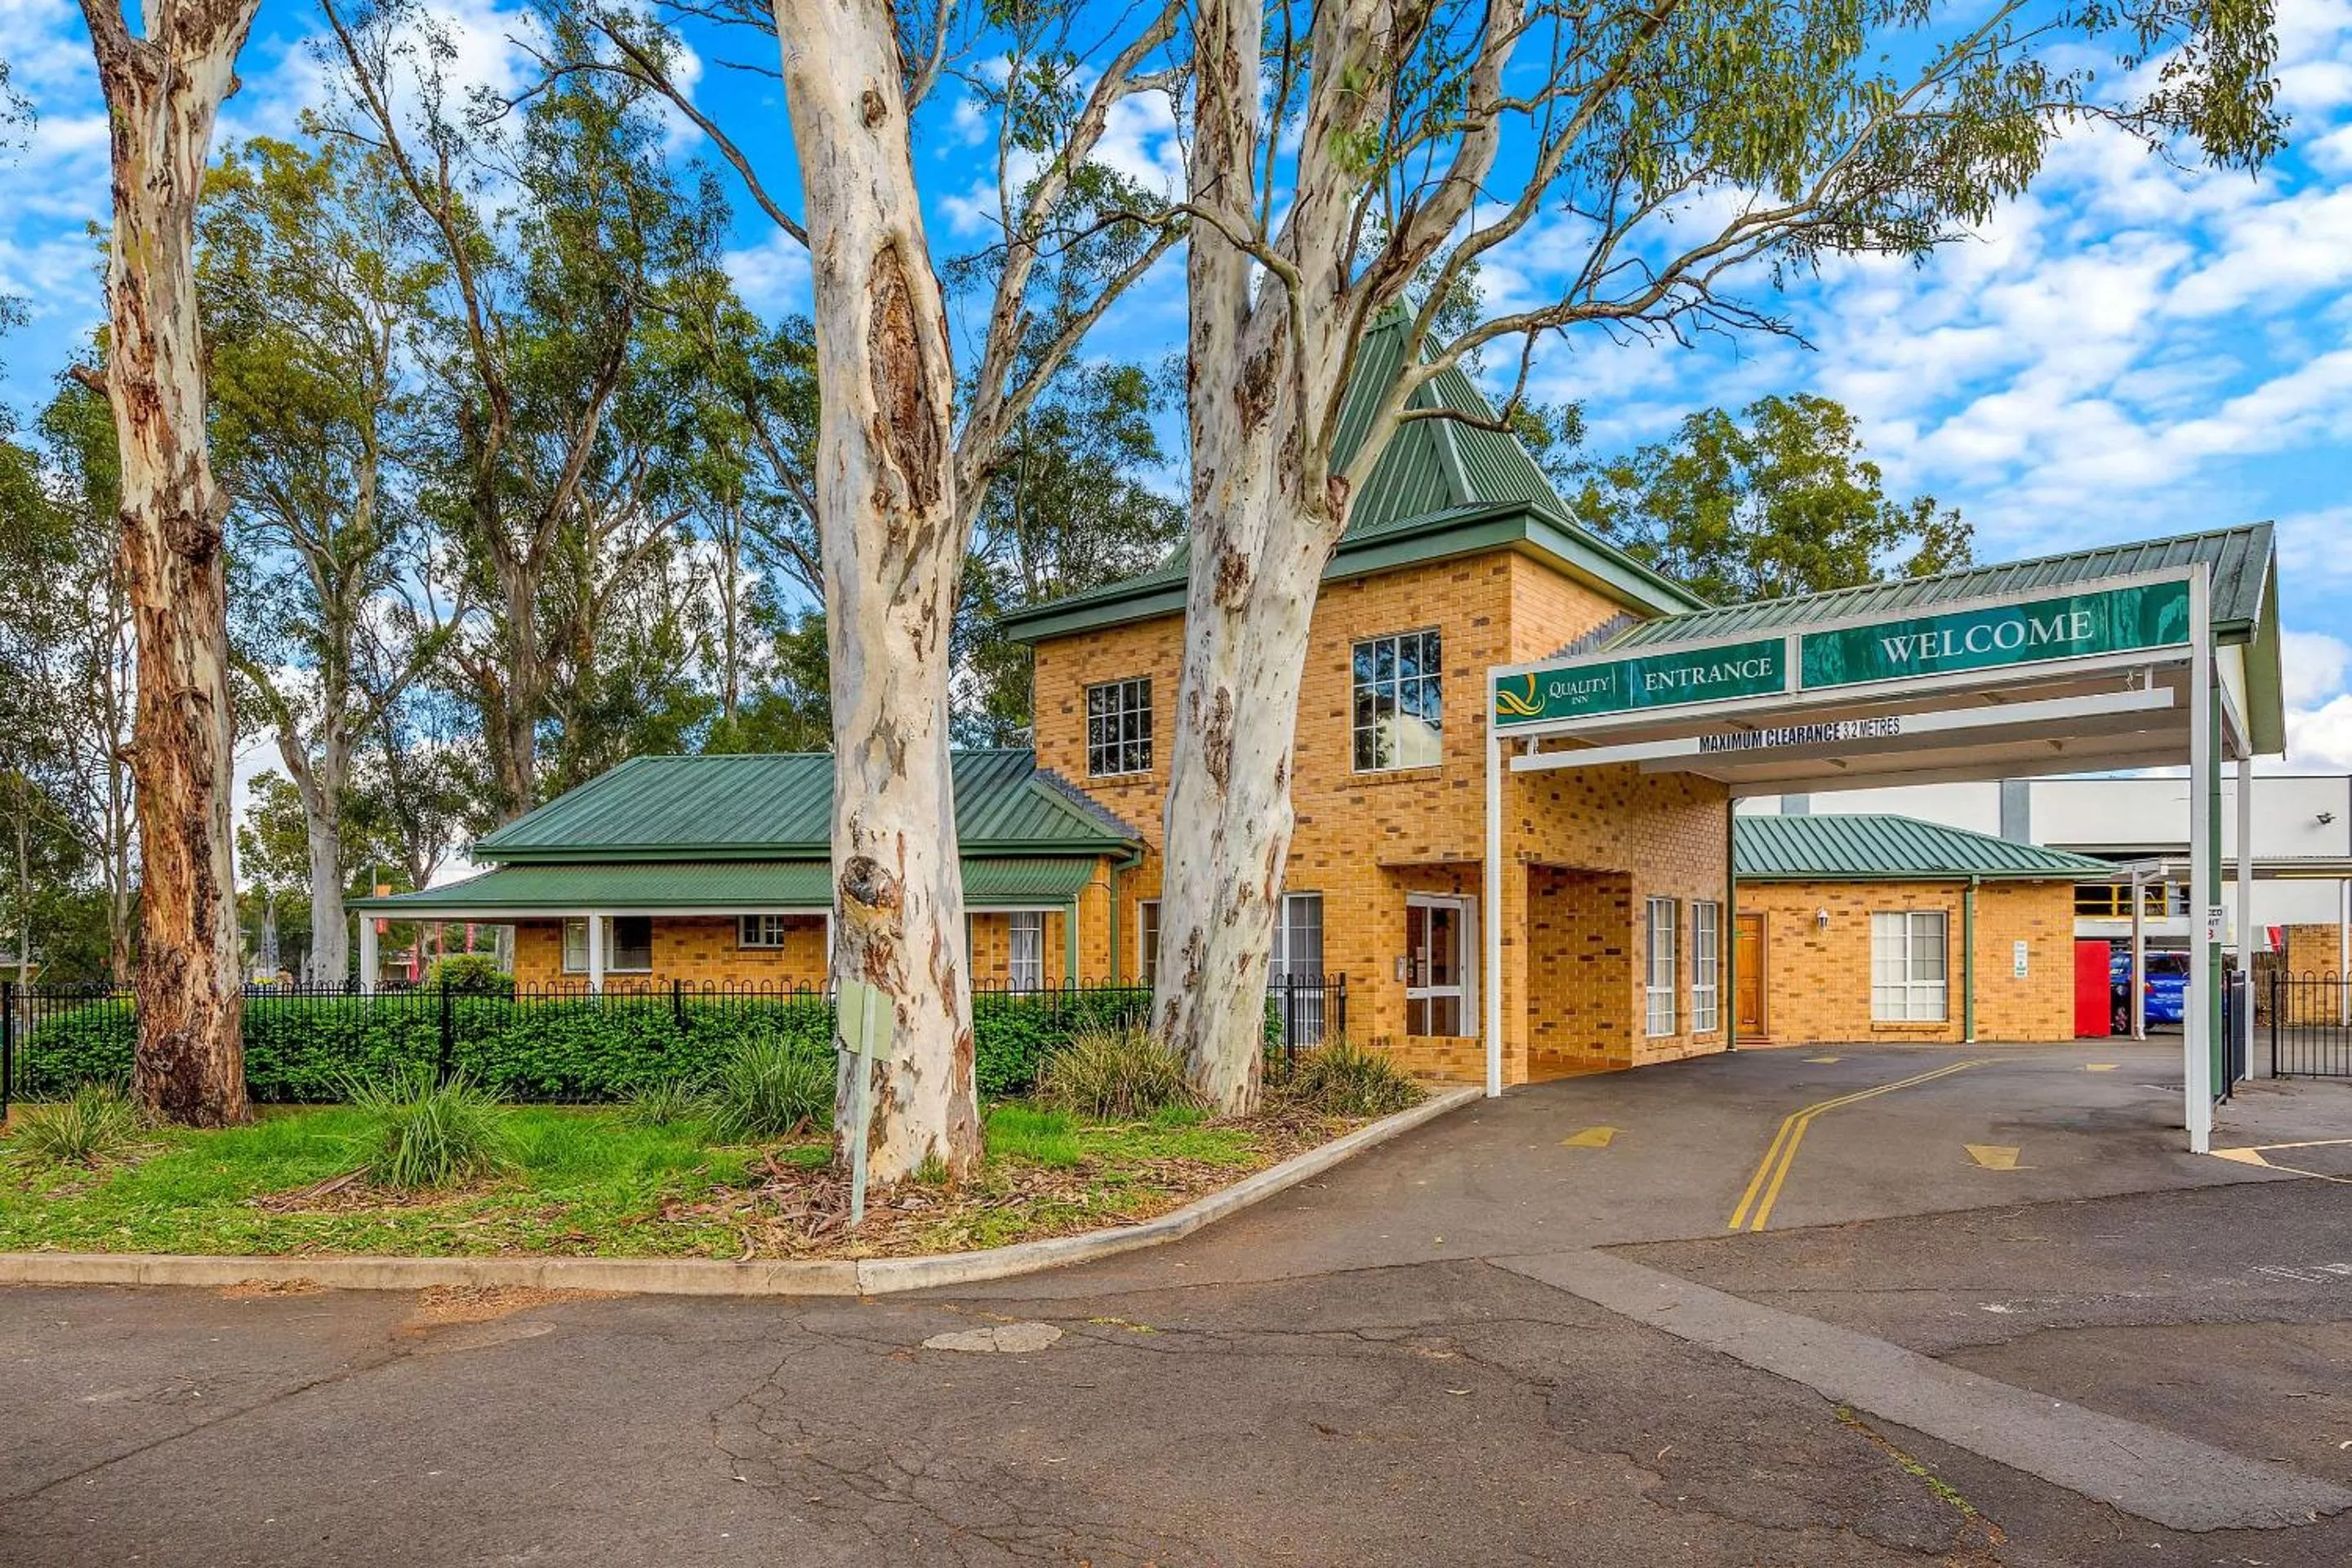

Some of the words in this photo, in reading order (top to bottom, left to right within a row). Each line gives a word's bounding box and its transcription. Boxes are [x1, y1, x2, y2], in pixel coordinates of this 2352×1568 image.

[1880, 611, 2094, 664] WELCOME
[1549, 676, 1610, 698] QUALITY
[1644, 657, 1773, 691] ENTRANCE
[1571, 695, 1588, 705] INN
[1699, 730, 1762, 752] MAXIMUM
[1766, 723, 1840, 746] CLEARANCE
[1860, 717, 1900, 737] METRES
